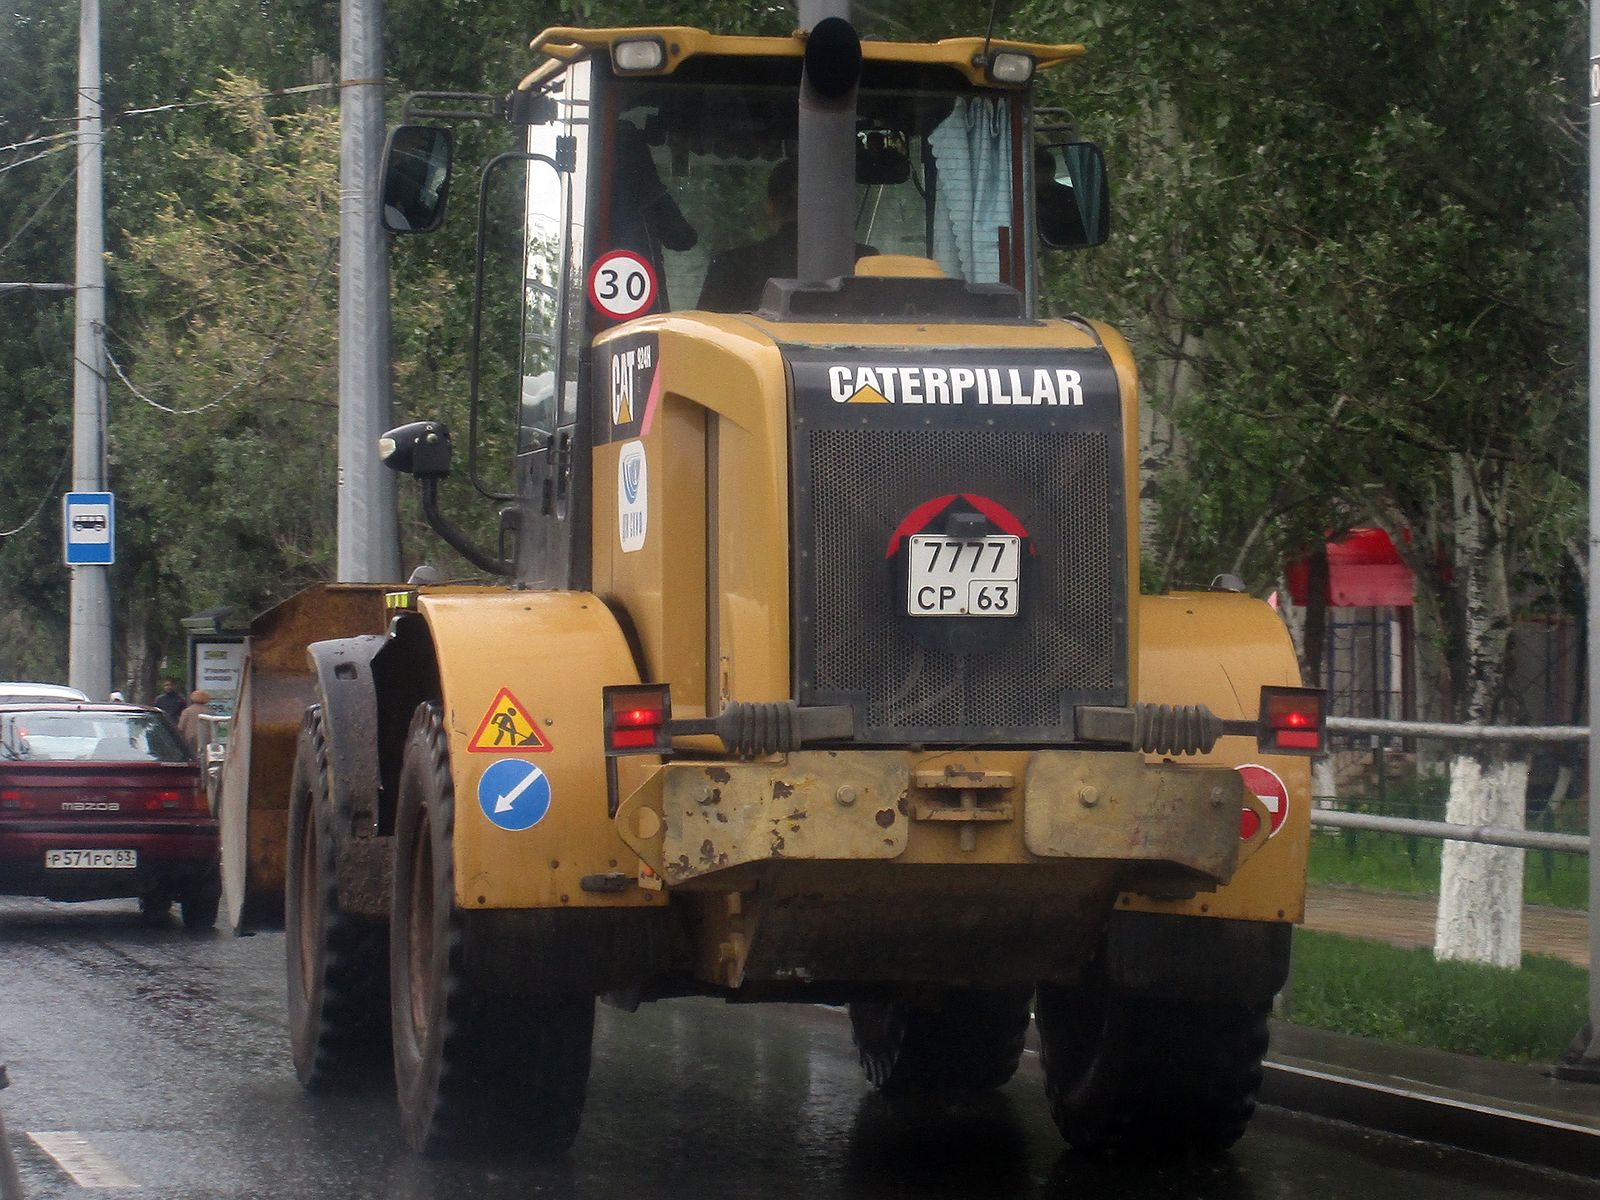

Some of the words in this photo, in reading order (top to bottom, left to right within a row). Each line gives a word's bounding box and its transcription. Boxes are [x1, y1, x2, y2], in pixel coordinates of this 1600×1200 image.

[599, 270, 646, 300] 30
[612, 351, 635, 425] CAT
[828, 366, 1084, 407] CATERPILLAR
[924, 542, 1006, 573] 7777
[977, 586, 1009, 610] 63
